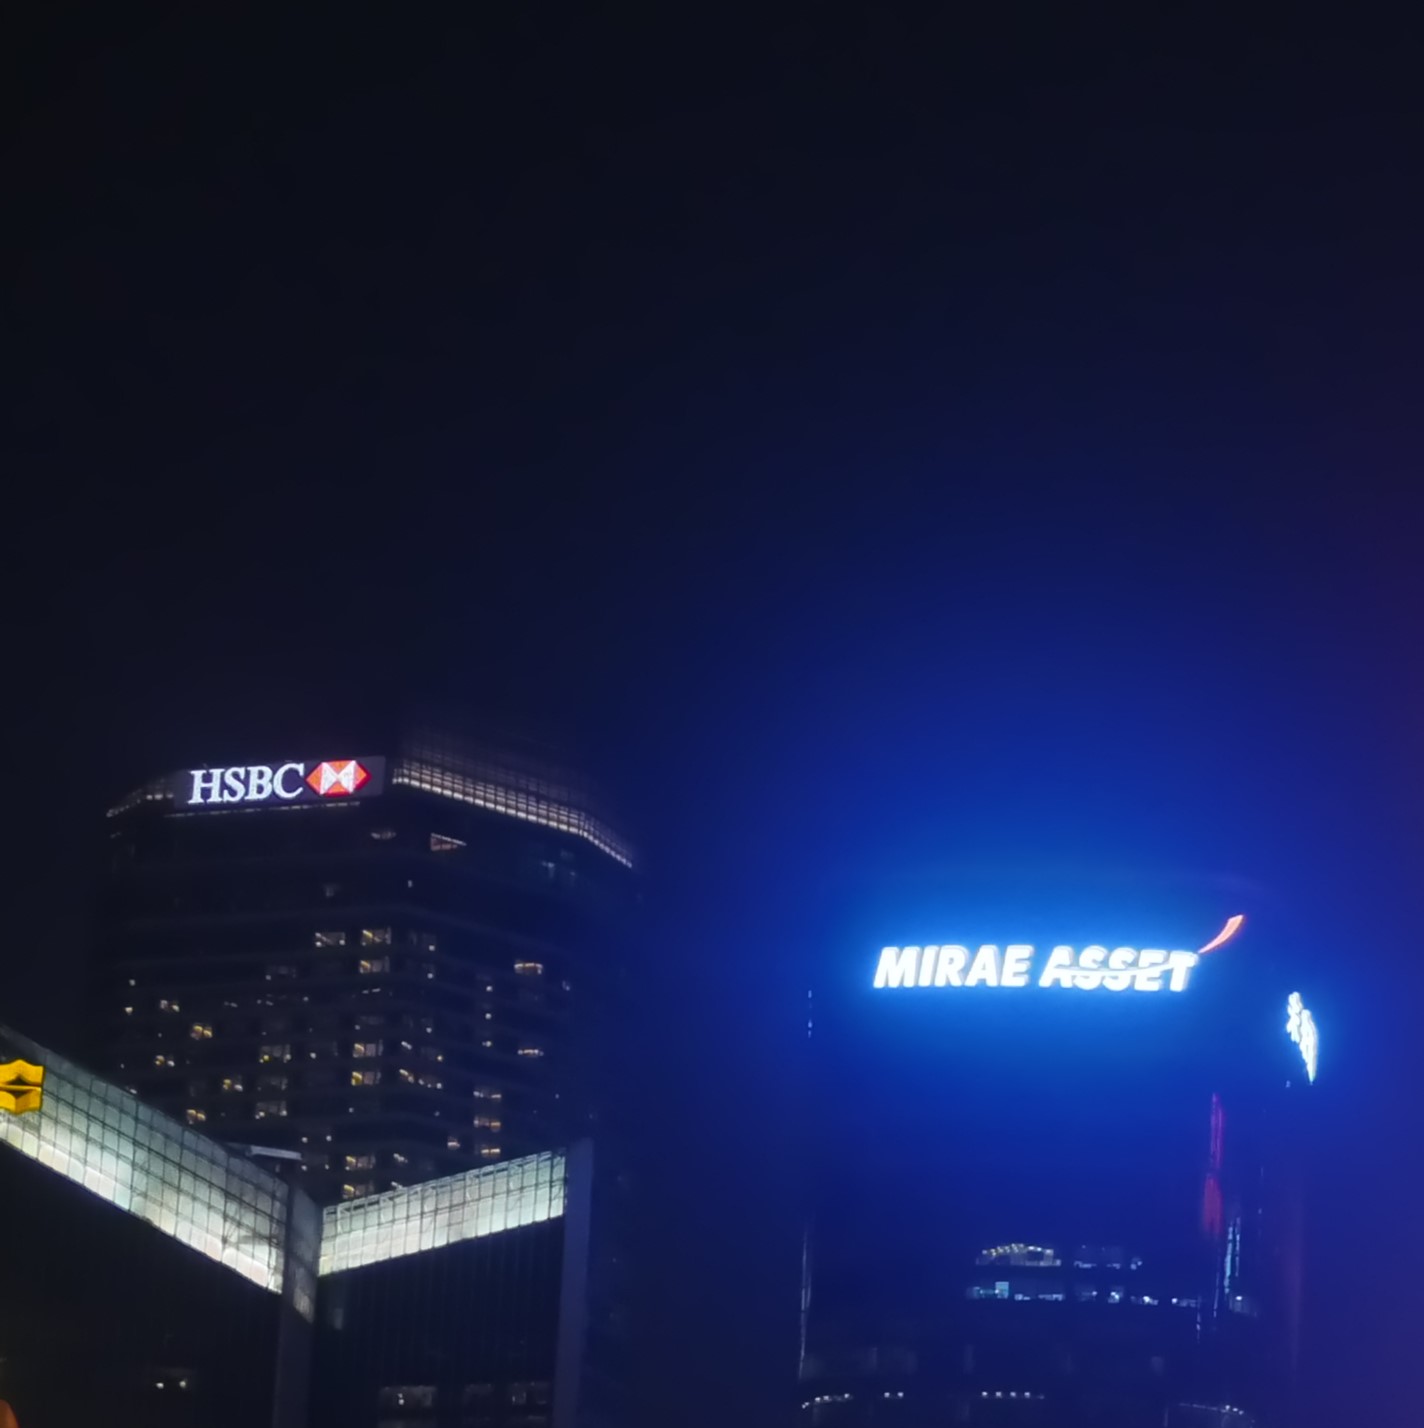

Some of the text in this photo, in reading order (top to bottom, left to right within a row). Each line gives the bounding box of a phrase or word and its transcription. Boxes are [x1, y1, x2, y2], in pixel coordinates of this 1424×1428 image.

[187, 761, 306, 806] HSBC
[873, 944, 1199, 993] MIRAE ASSET
